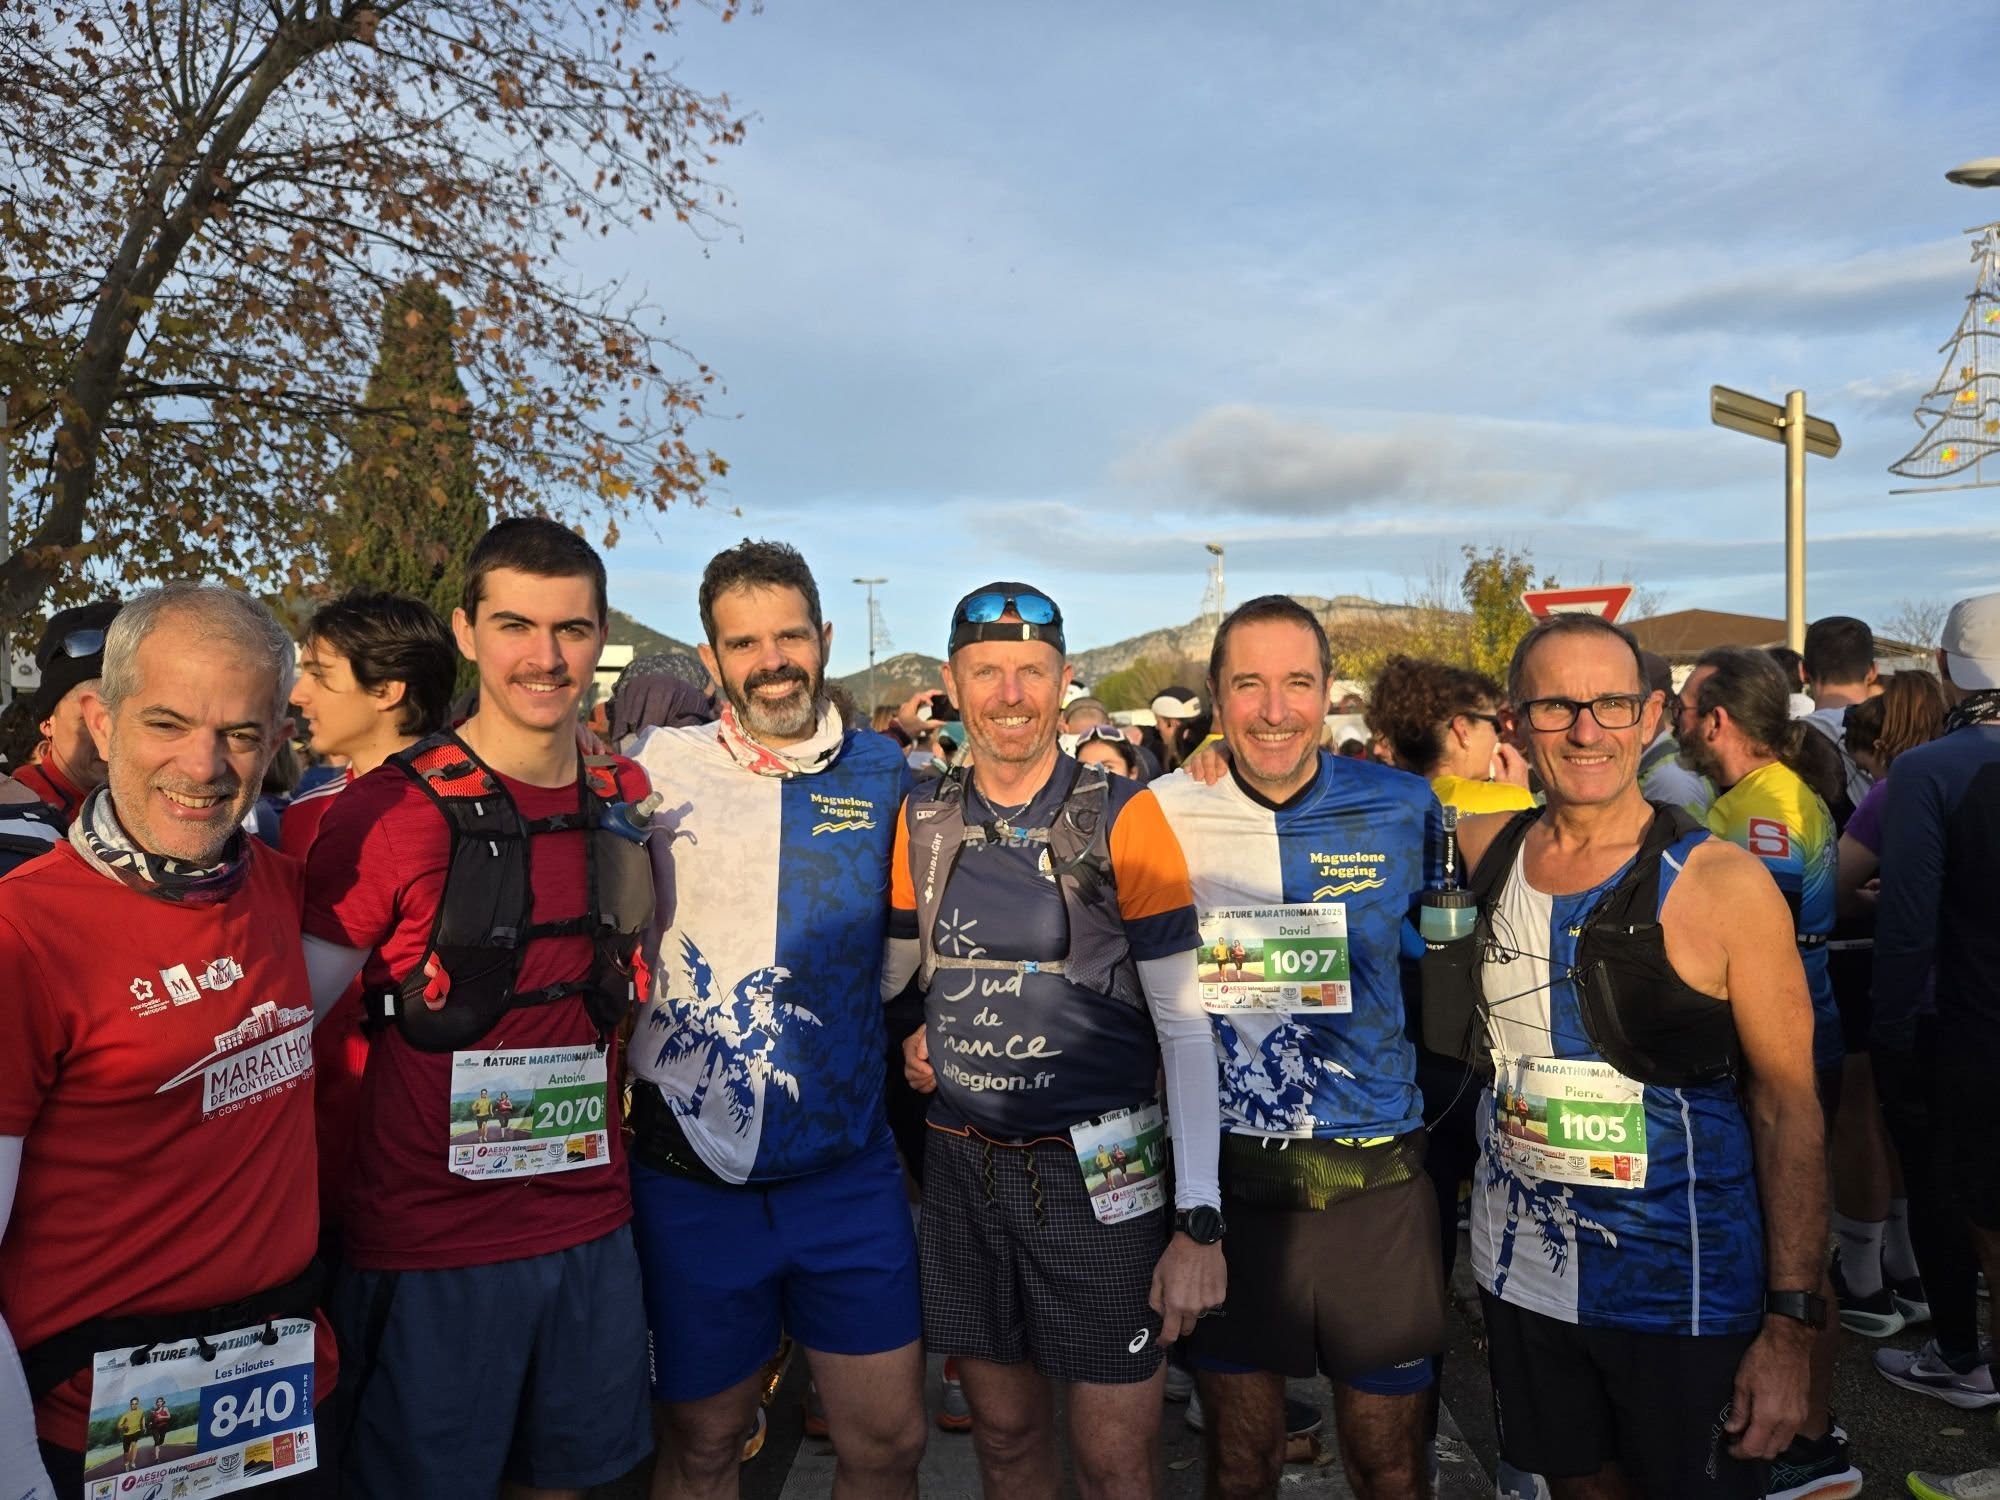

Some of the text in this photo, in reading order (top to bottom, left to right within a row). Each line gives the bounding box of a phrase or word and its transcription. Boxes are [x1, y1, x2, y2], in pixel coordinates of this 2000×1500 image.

[810, 793, 873, 808] Maguelone
[820, 805, 870, 819] Jogging
[927, 832, 944, 884] RAIDLIGHT
[1310, 852, 1385, 865] Maguelone
[1320, 865, 1376, 878] Jogging
[1254, 909, 1319, 919] MARATHONMAN
[1279, 925, 1311, 936] David
[1270, 949, 1337, 975] 1097
[973, 1006, 1004, 1027] de
[548, 1071, 586, 1085] Antoine
[211, 1090, 226, 1107] DE
[218, 1099, 247, 1117] coeur
[249, 1092, 263, 1105] de
[535, 1095, 601, 1130] 2070
[1560, 1113, 1627, 1143] 1105
[281, 1322, 311, 1337] 2025
[214, 1358, 275, 1380] Les biloutes
[210, 1380, 296, 1438] 840
